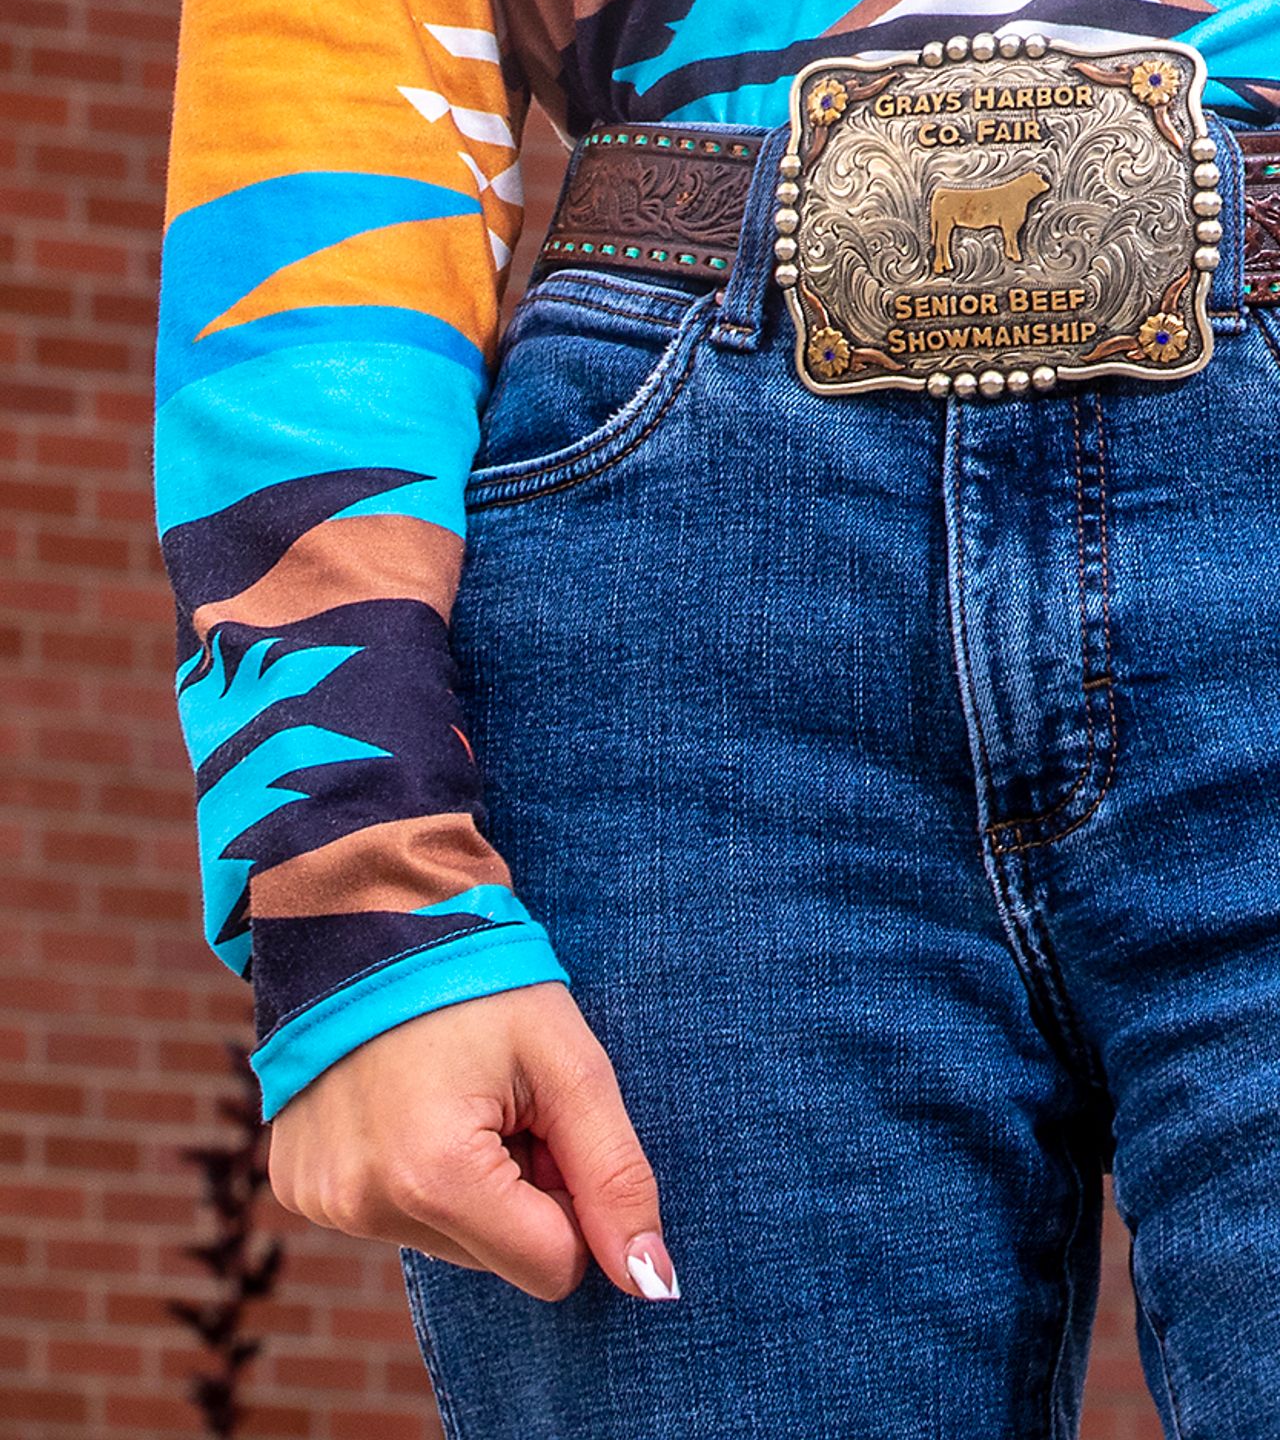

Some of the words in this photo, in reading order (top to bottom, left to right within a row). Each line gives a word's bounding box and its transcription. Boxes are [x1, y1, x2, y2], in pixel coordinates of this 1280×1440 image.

[875, 93, 962, 117] GRAYS
[972, 85, 1094, 110] HARBOR
[976, 119, 1042, 143] FAIR
[894, 293, 999, 320] SENIOR
[1008, 288, 1086, 312] BEEF
